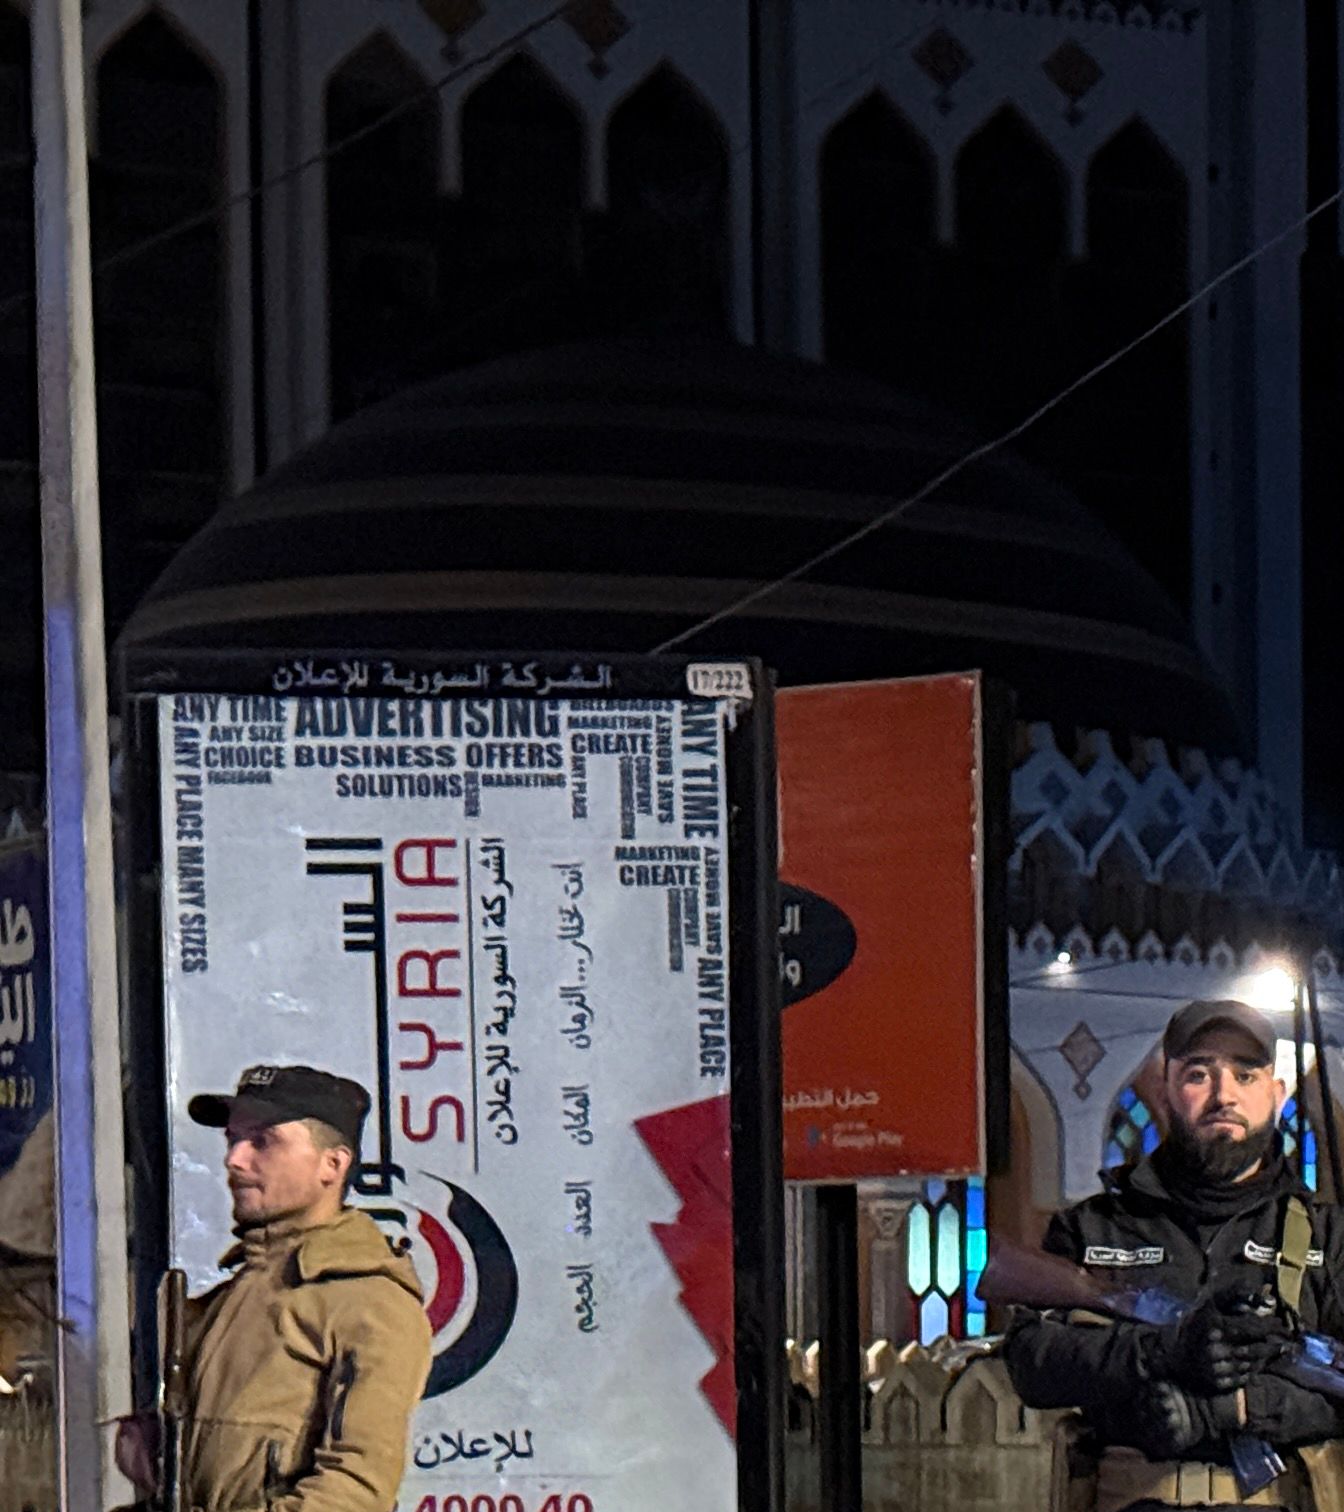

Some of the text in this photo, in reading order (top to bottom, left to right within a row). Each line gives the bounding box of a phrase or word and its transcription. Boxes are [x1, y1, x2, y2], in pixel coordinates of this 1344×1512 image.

[273, 659, 370, 695] للإعلان
[381, 660, 490, 695] السورية
[227, 698, 287, 723] TIME
[293, 698, 561, 739] ADVERTISING
[209, 725, 285, 742] ANY SIZE
[571, 733, 652, 755] CREATE
[204, 745, 286, 769] CHOICE
[294, 742, 563, 769] BUSINESS OFFERS
[681, 700, 720, 840] ANY TIME
[336, 773, 464, 799] SOLUTIONS
[481, 773, 567, 788] MARKETING
[656, 779, 674, 824] SAVE
[173, 726, 209, 974] ANY PLACE MANY SIZES
[614, 845, 701, 862] MARKETING
[618, 864, 701, 887] CREATE
[393, 837, 466, 1144] SYRIA
[481, 836, 521, 1146] الشركة السورية للإعلان
[697, 957, 727, 1078] ANY PLACE
[562, 1084, 596, 1147] المكان
[563, 1180, 595, 1239] العدد
[565, 1262, 601, 1335] الحجم
[413, 1428, 535, 1472] للإعلان
